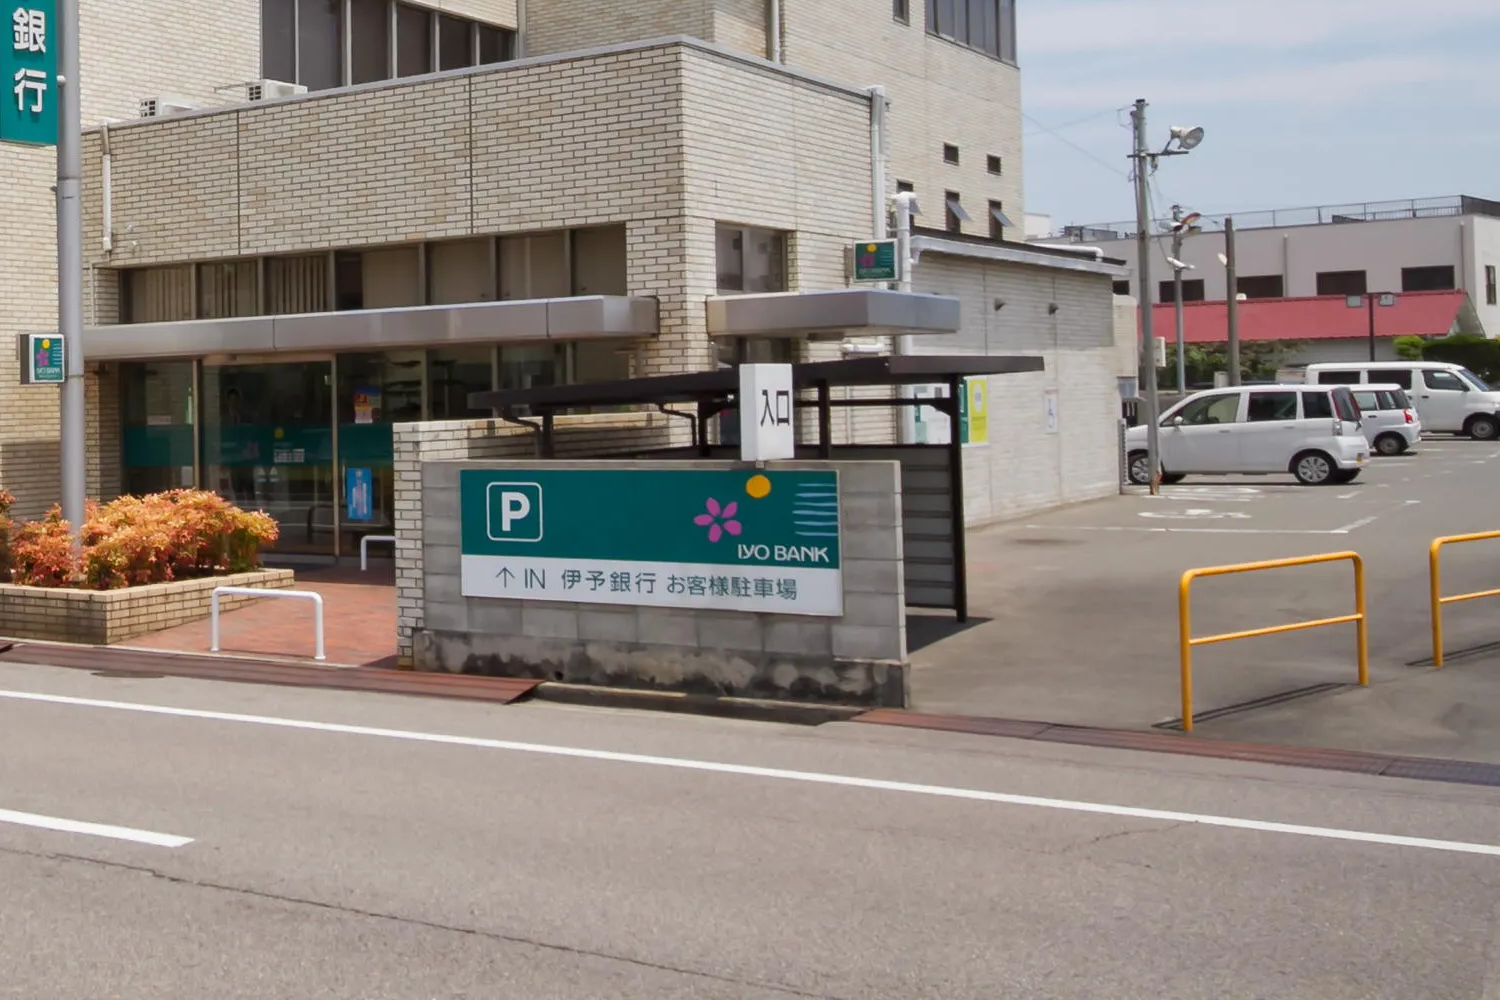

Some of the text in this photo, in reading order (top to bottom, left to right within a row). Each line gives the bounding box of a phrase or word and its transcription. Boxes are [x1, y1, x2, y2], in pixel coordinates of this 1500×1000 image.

[760, 389, 790, 427] 入口
[501, 491, 531, 532] P
[737, 543, 830, 563] IYO BANK
[524, 567, 798, 600] IN 伊予銀行 お客様駐車場
